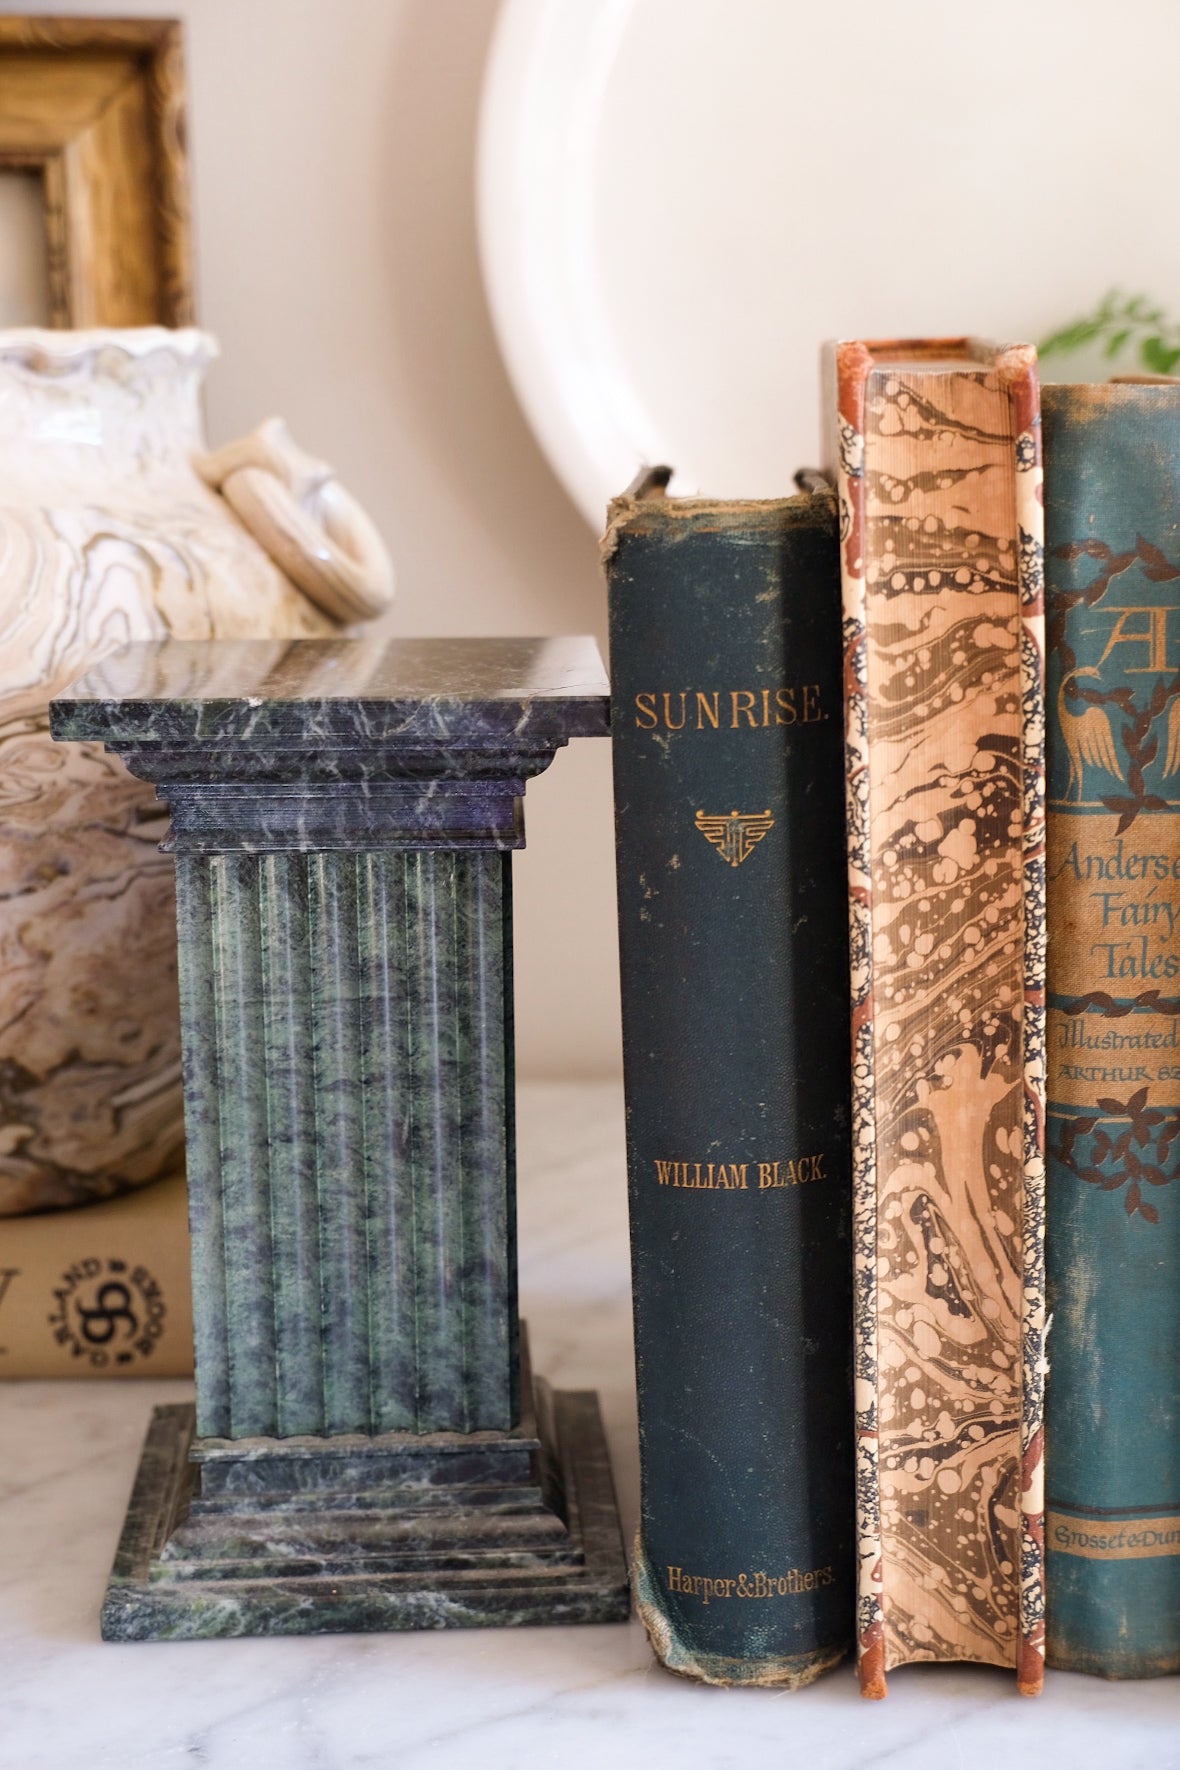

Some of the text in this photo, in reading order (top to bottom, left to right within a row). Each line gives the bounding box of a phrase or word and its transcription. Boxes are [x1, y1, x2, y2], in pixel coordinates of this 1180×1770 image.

[635, 685, 829, 729] SUNRISE.
[1090, 935, 1180, 979] Tales
[1057, 1018, 1180, 1050] Illustrated
[1058, 1064, 1153, 1081] ARTHUR
[654, 1153, 827, 1190] WILLIAM BLACK.
